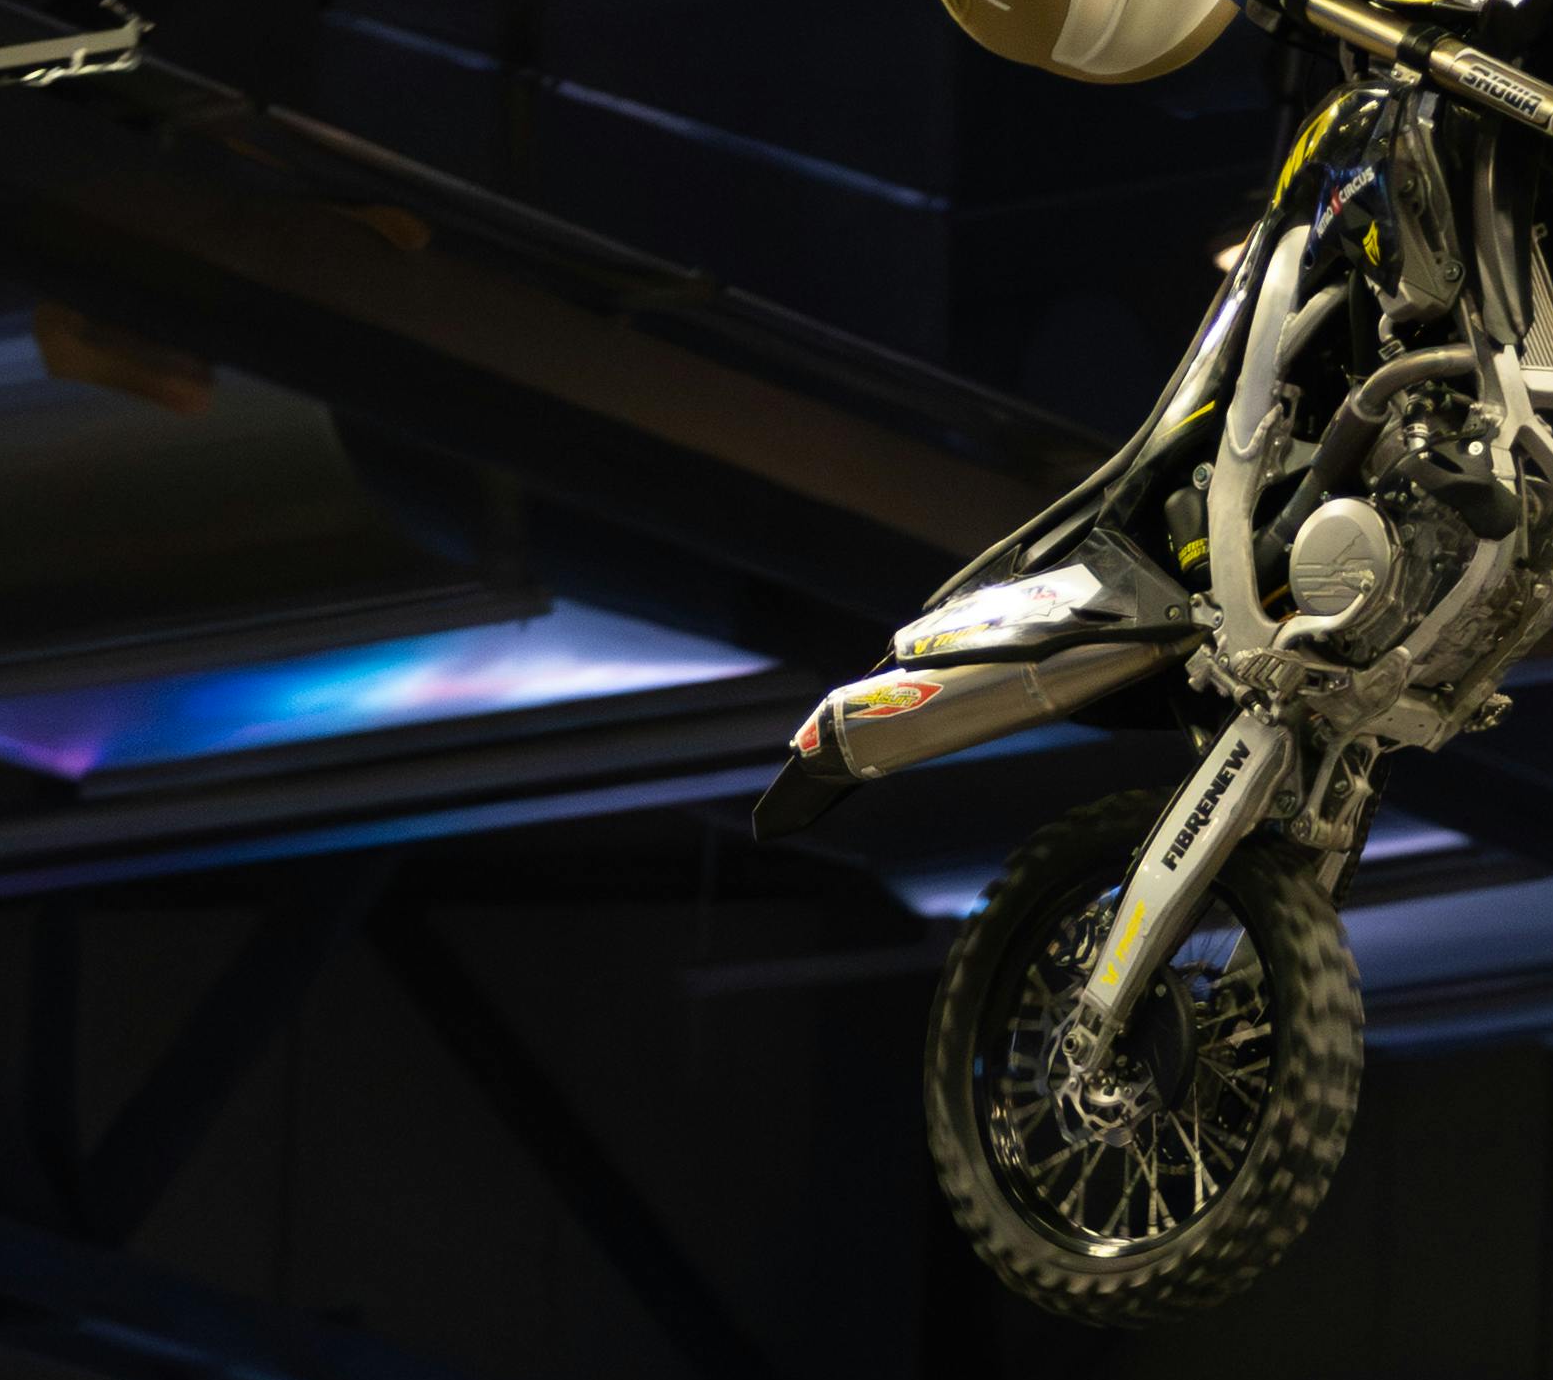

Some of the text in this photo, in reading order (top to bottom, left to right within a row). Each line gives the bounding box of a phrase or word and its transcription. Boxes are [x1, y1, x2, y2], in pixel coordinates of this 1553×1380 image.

[1459, 64, 1546, 119] SHOWA
[1338, 166, 1376, 204] CIRCUS
[1160, 738, 1251, 872] FIBRENEW
